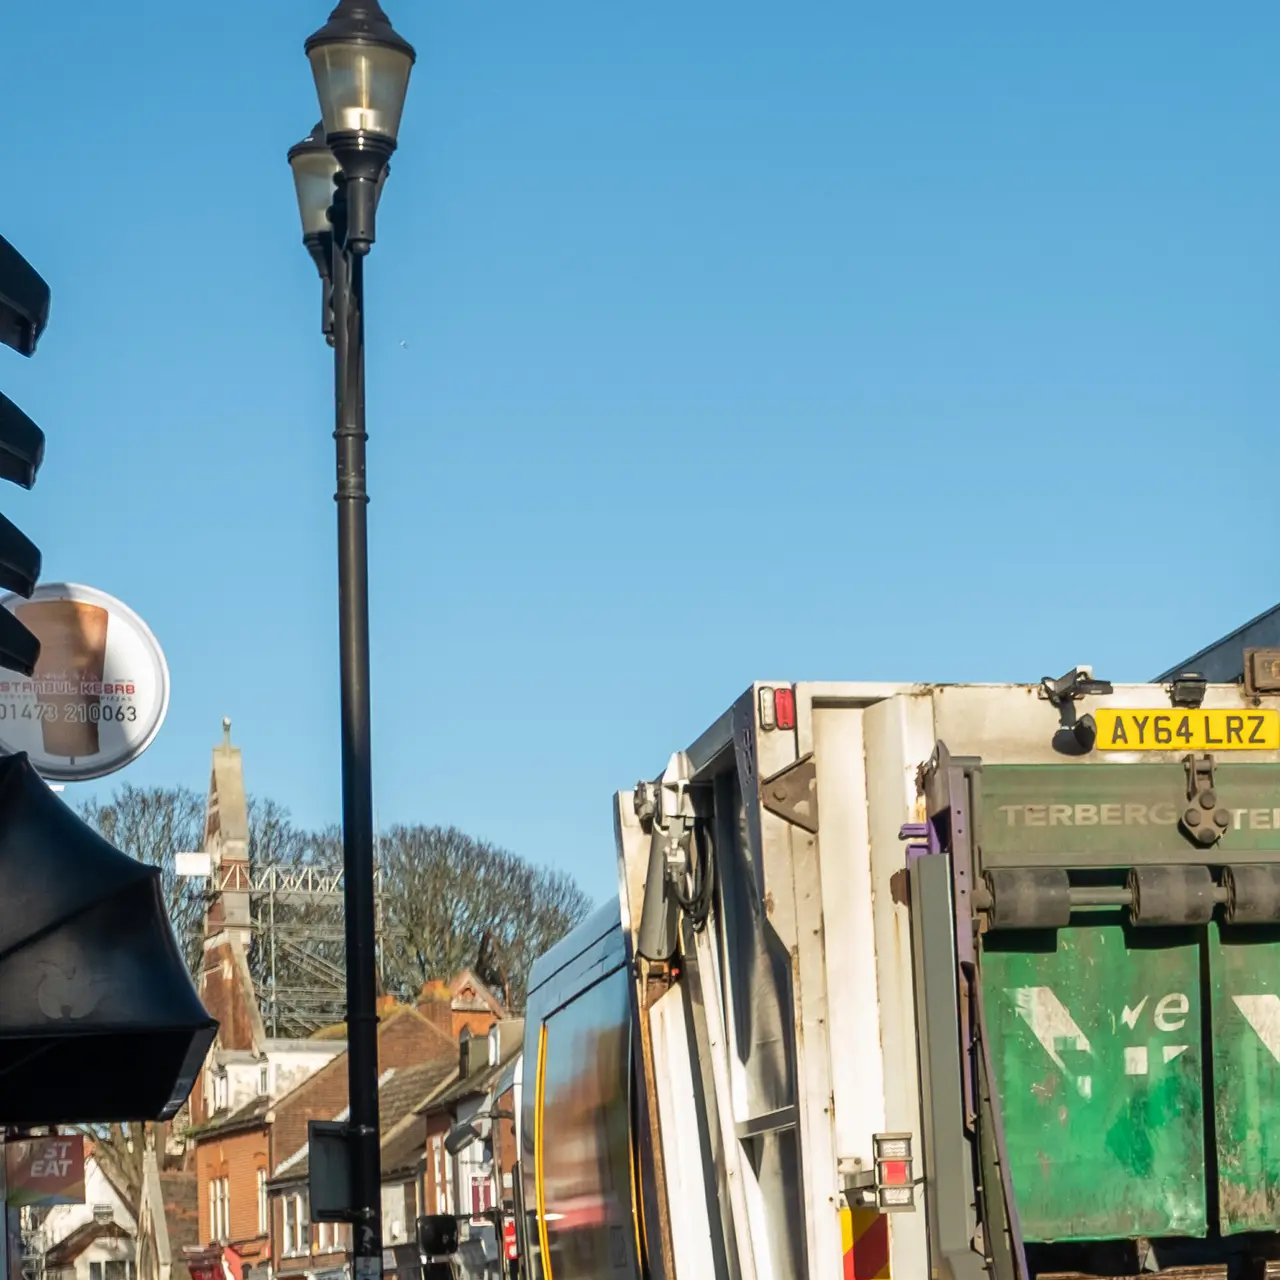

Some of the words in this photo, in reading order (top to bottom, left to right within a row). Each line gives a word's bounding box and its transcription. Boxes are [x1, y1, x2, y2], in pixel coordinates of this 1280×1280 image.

[80, 681, 136, 696] KEBAB
[63, 705, 137, 723] 210063
[1110, 715, 1195, 745] AY64
[1205, 715, 1266, 745] LRZ
[1001, 802, 1178, 827] TERBERG
[30, 1160, 72, 1177] EAT
